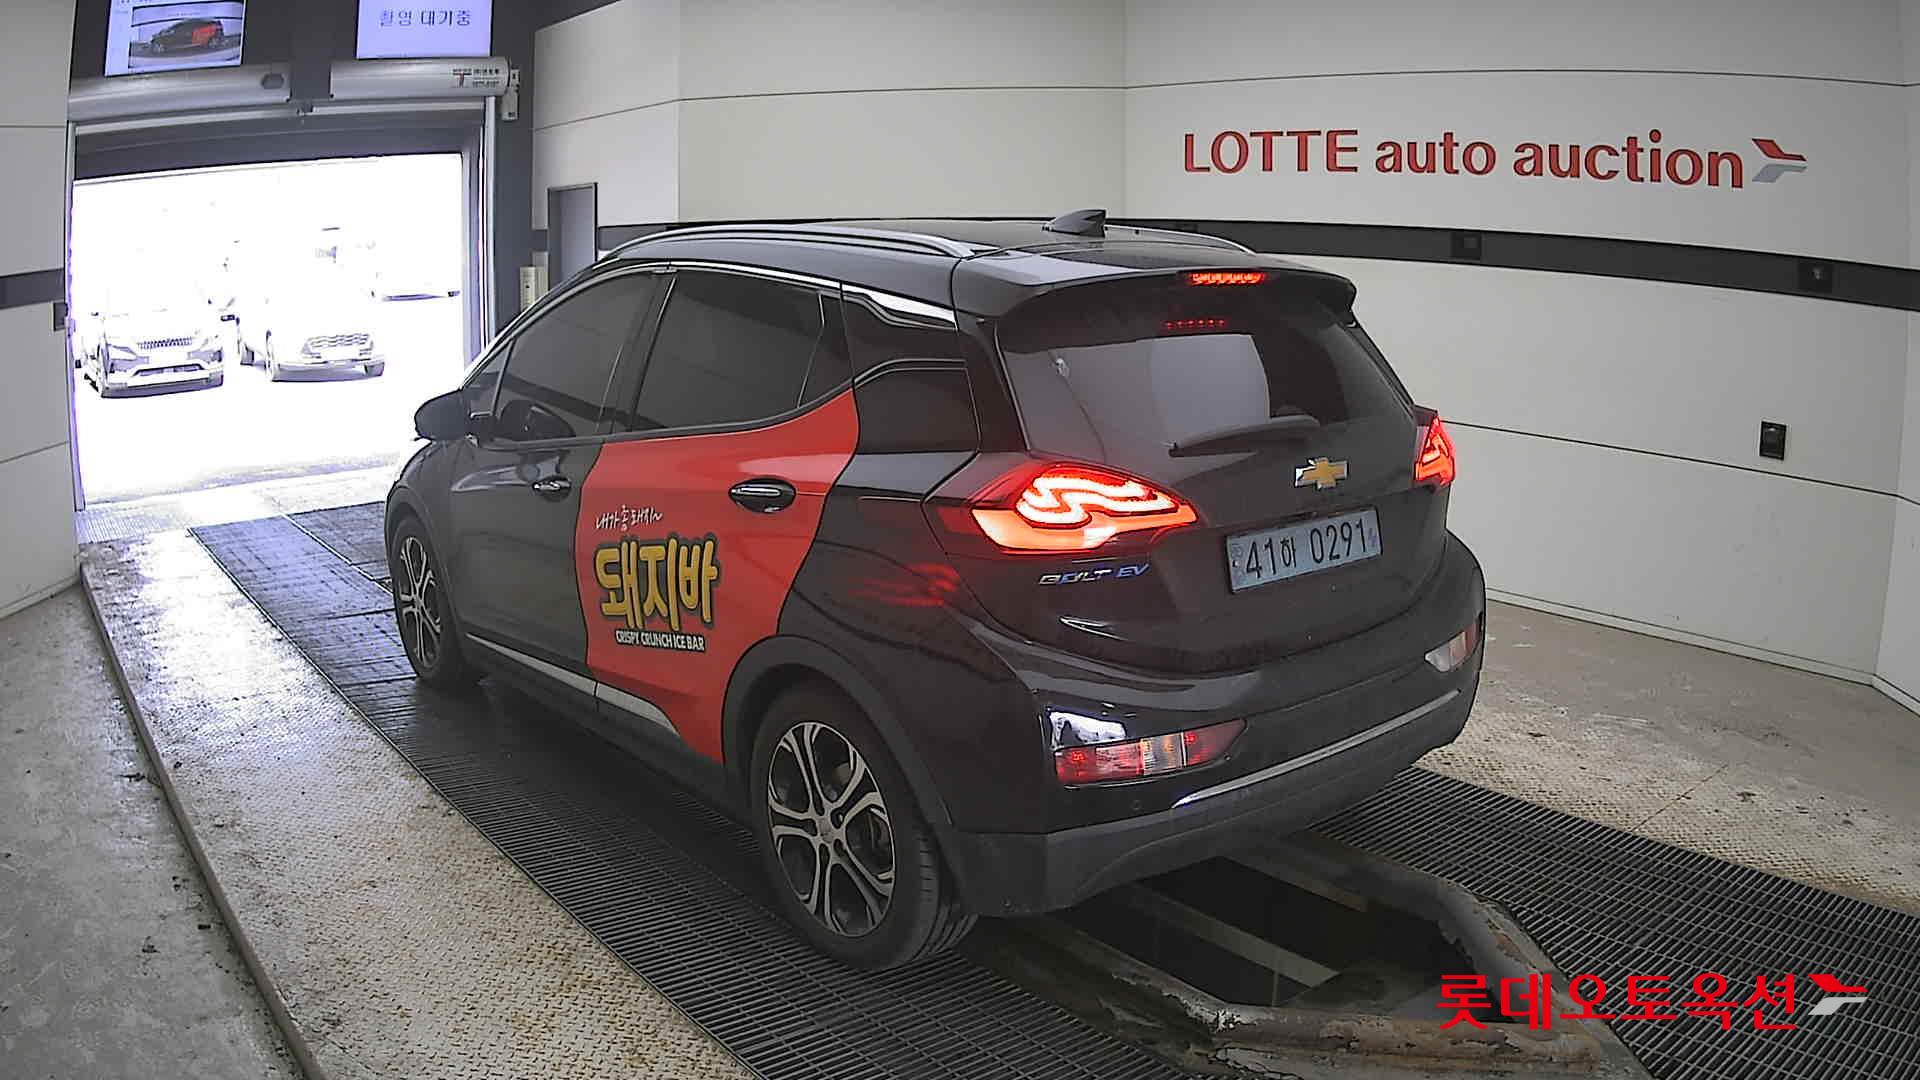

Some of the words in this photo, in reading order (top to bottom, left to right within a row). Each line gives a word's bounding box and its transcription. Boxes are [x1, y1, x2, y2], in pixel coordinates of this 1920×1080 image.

[421, 9, 470, 26] 대기중
[1184, 129, 1359, 174] LOTTE
[1375, 131, 1496, 176] auto
[1513, 129, 1744, 189] auction
[1246, 537, 1297, 578] 41하
[1309, 517, 1366, 564] 0291
[594, 537, 720, 632] 돼지바
[1039, 568, 1112, 585] BOLT
[1116, 563, 1150, 578] EV
[615, 630, 640, 645] CRISPY
[640, 632, 673, 648] CRUNCH
[672, 635, 687, 649] ICE
[686, 636, 705, 651] BAR
